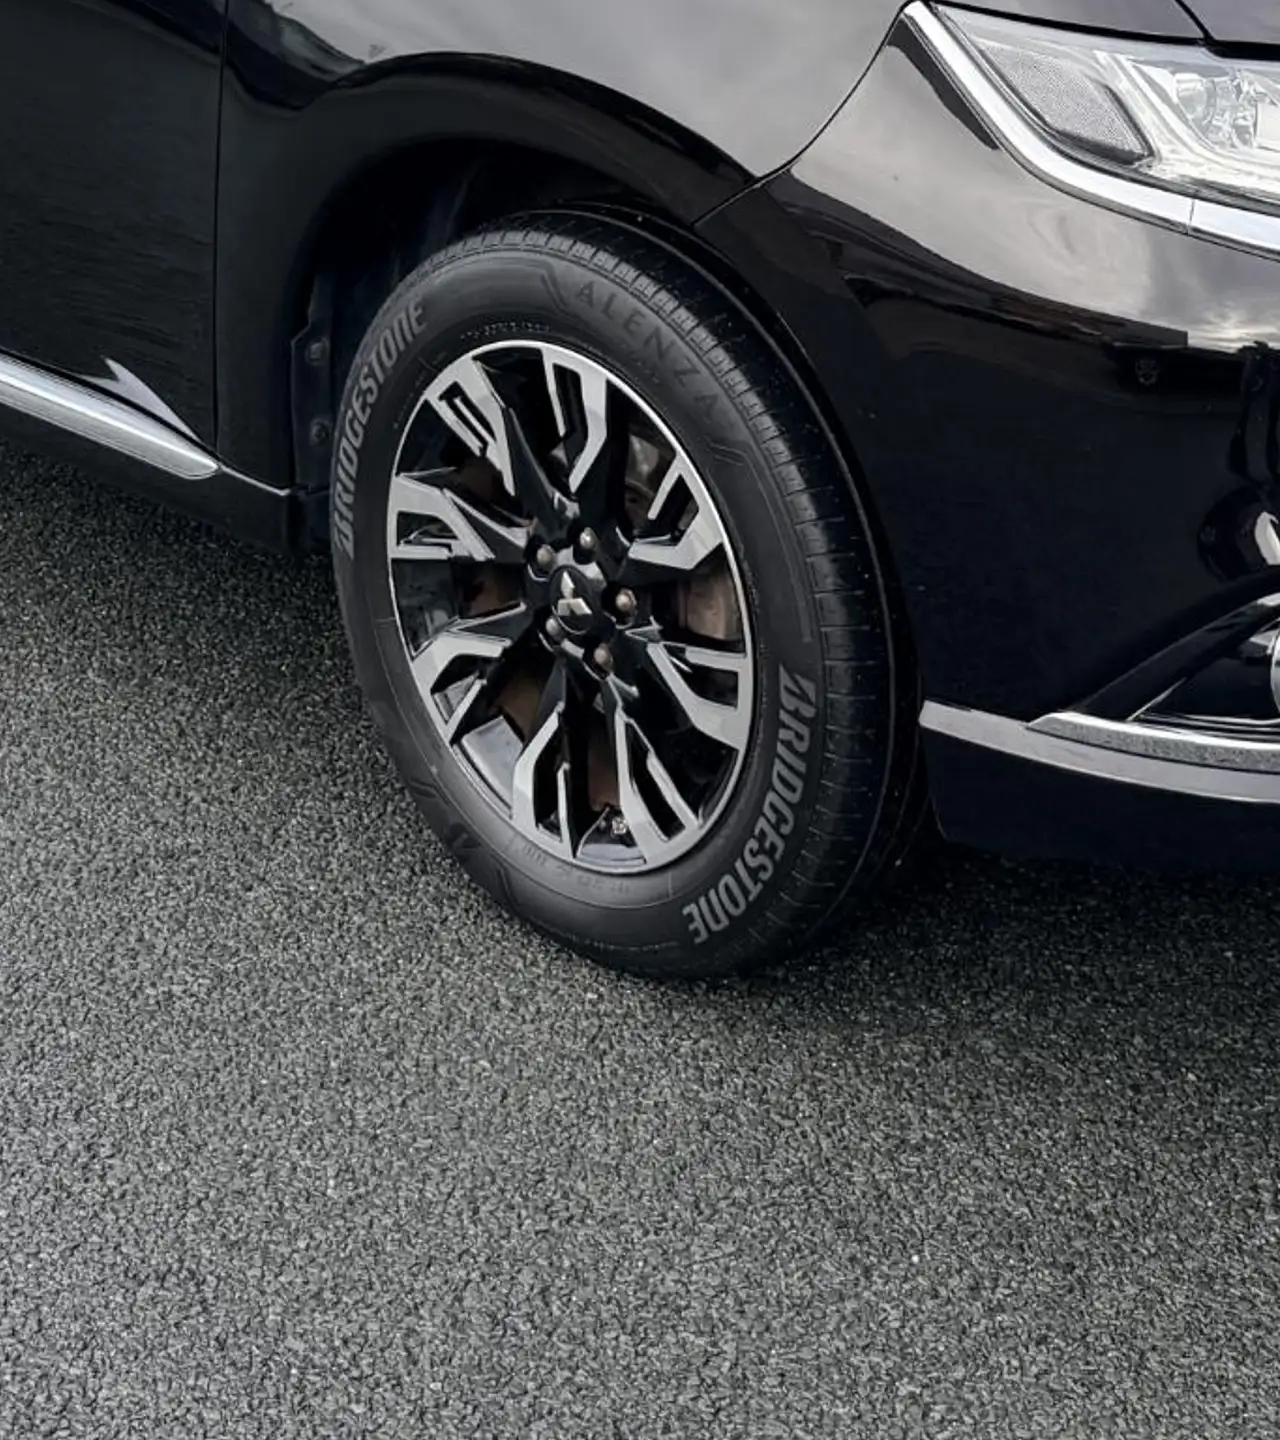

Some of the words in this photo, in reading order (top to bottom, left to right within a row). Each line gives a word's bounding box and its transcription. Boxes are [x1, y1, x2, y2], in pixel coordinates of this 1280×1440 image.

[330, 302, 427, 560] BRIDGESTONE
[578, 280, 720, 416] ALENZA
[681, 664, 817, 946] BRIDGESTONE
